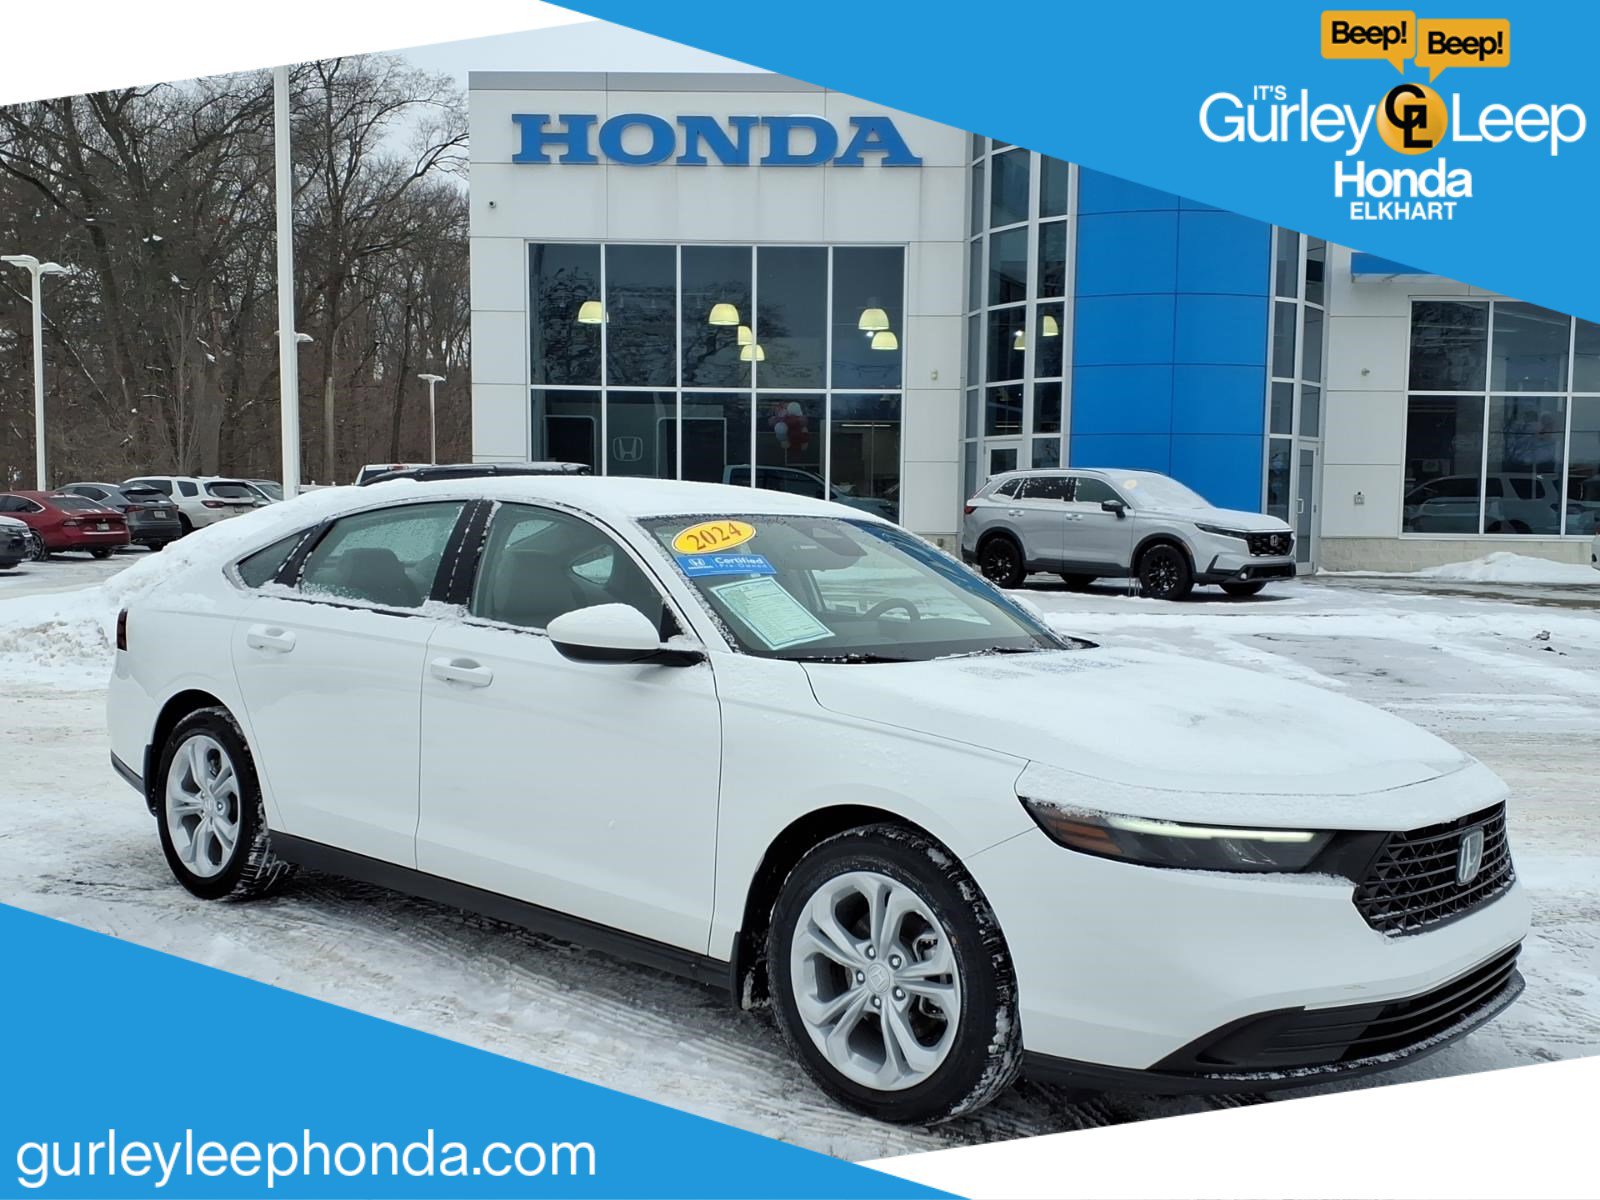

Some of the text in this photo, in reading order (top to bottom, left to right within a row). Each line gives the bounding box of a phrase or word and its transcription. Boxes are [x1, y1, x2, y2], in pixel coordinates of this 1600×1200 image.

[511, 112, 924, 167] HONDA
[686, 522, 742, 551] 2024
[714, 557, 764, 565] Certified
